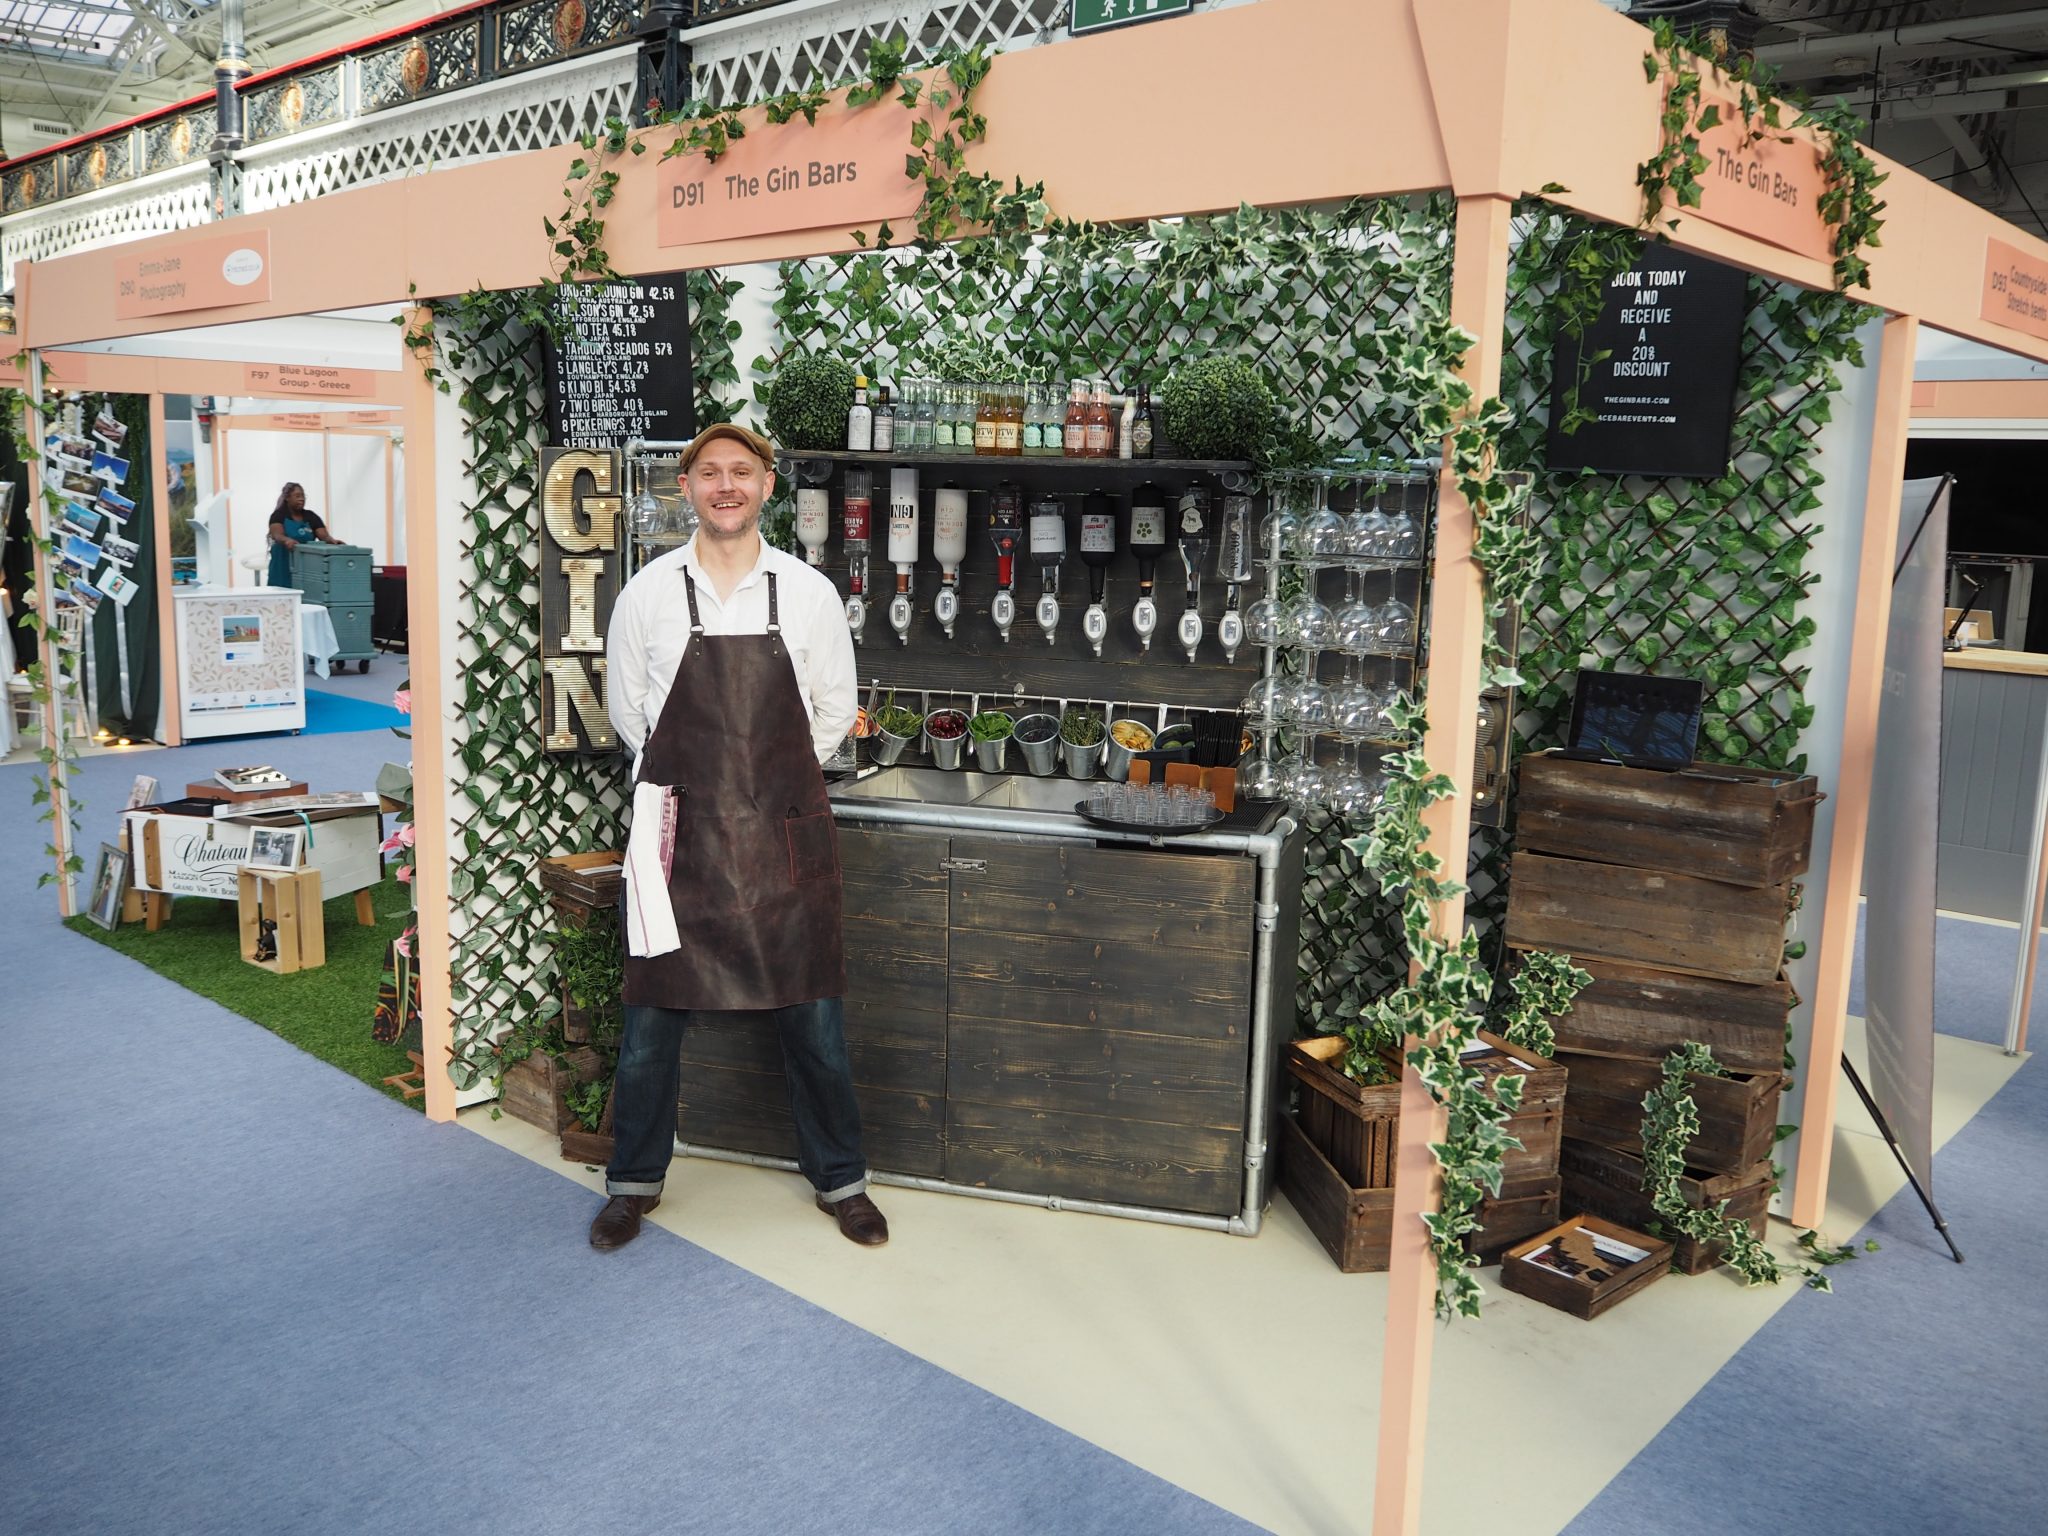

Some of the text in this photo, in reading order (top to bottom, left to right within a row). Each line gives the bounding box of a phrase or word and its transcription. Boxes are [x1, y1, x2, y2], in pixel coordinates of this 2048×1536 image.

[672, 160, 857, 208] D91 The Gin Bars
[1717, 147, 1798, 207] The Gin Bars
[139, 257, 181, 278] Emma-Jane
[1648, 270, 1687, 286] TODAY
[140, 281, 186, 300] Photography
[630, 286, 644, 300] GIN
[648, 286, 674, 300] 42.5%
[1634, 290, 1658, 305] AND
[609, 304, 623, 317] GIN
[628, 305, 655, 319] 42.5%
[1620, 308, 1672, 324] RECEIVE
[576, 323, 588, 336] NO
[591, 324, 608, 336] TEA
[612, 324, 637, 337] 45.1%
[1638, 328, 1646, 342] A
[614, 342, 650, 355] SEADOG
[655, 343, 673, 355] 57%
[1632, 346, 1655, 361] 20%
[280, 366, 338, 378] Blue Lagoon
[558, 360, 649, 374] 5 LANGLEY'S 41.7%
[1613, 362, 1671, 377] DISCOUNT
[251, 370, 270, 379] F97
[280, 378, 309, 388] Group
[319, 380, 351, 389] Greece
[560, 380, 636, 393] 6 KI NO BI 54.5%
[560, 400, 566, 413] 7
[569, 400, 590, 412] TWO
[592, 400, 618, 412] BIRDS
[562, 420, 568, 432] 8
[570, 418, 625, 432] PICKERING'S
[976, 428, 994, 436] BTW
[564, 438, 570, 448] 9
[572, 437, 597, 448] EDEN
[600, 436, 620, 448] MILL
[892, 505, 911, 518] GIN
[544, 449, 622, 750] GIN
[173, 834, 248, 872] Chateau
